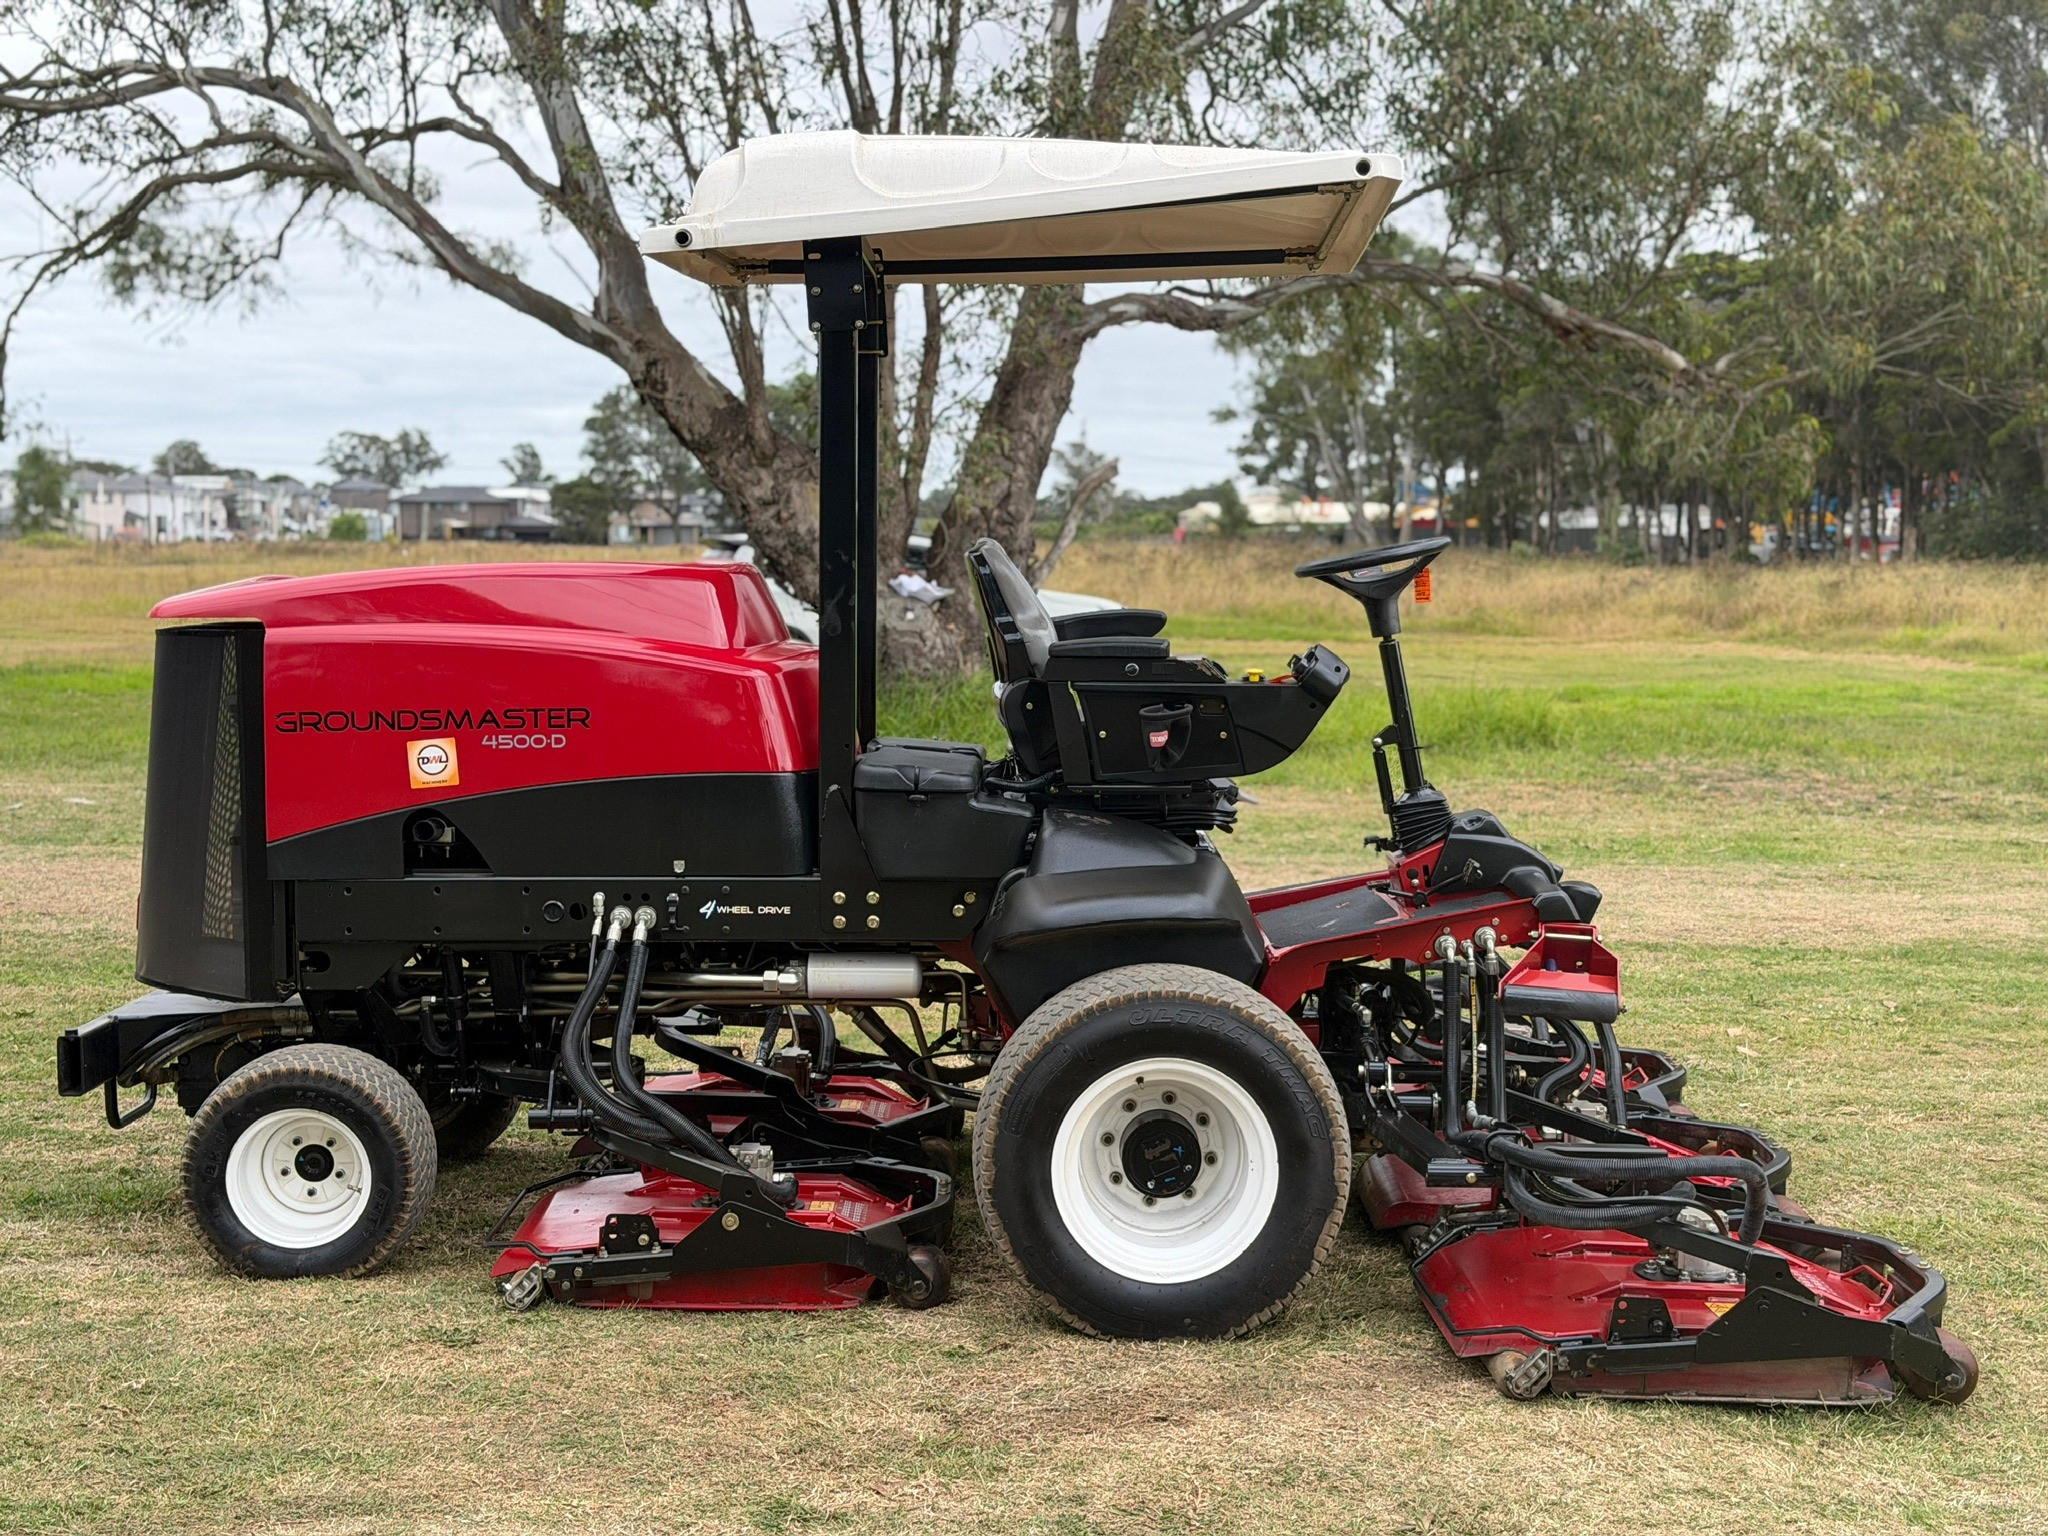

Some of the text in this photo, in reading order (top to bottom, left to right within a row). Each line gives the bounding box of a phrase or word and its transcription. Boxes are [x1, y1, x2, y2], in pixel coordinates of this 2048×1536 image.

[275, 707, 591, 733] GROUNDSMASTER
[1150, 734, 1168, 743] TORO
[418, 755, 448, 766] DWL
[699, 899, 791, 920] 4 WHEEL DRIVE
[1128, 1007, 1327, 1140] ULTRA TRAC
